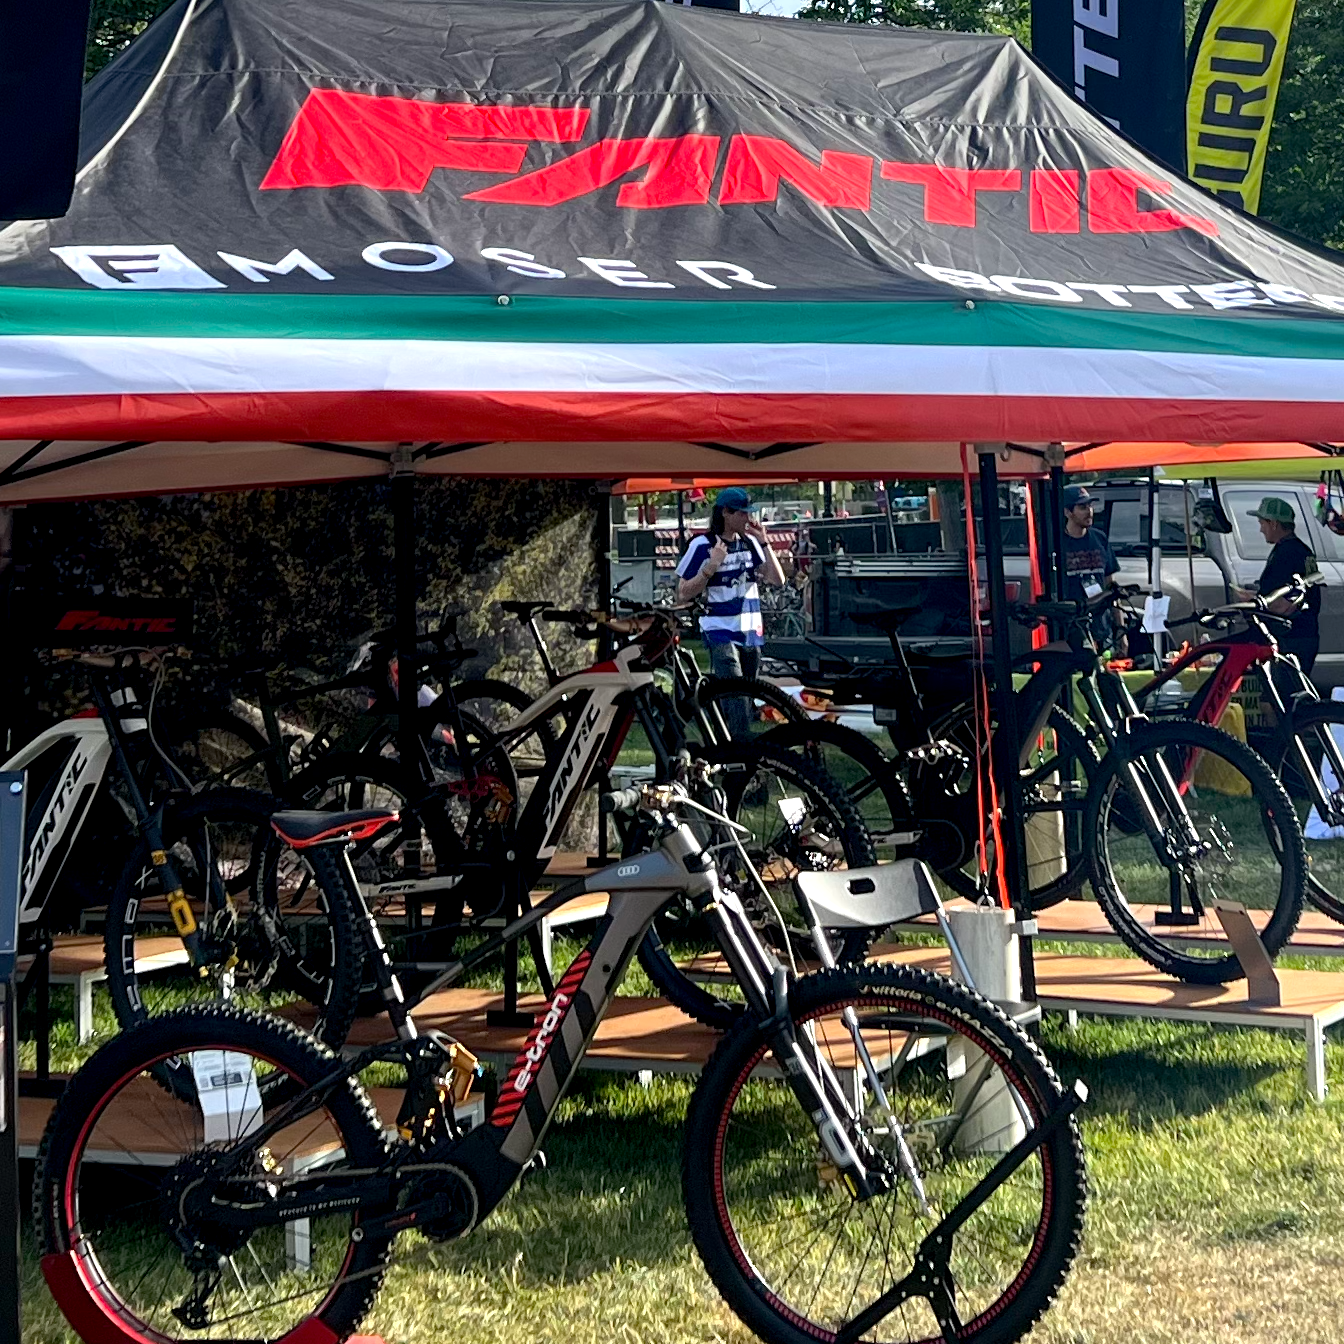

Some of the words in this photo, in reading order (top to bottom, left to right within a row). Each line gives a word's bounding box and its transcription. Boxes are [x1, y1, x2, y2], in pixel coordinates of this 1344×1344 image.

[258, 86, 1220, 235] FANTIC
[216, 241, 778, 291] MOSER
[54, 609, 178, 633] FANTIC
[871, 985, 922, 1001] vittoria
[513, 992, 569, 1093] e-tron
